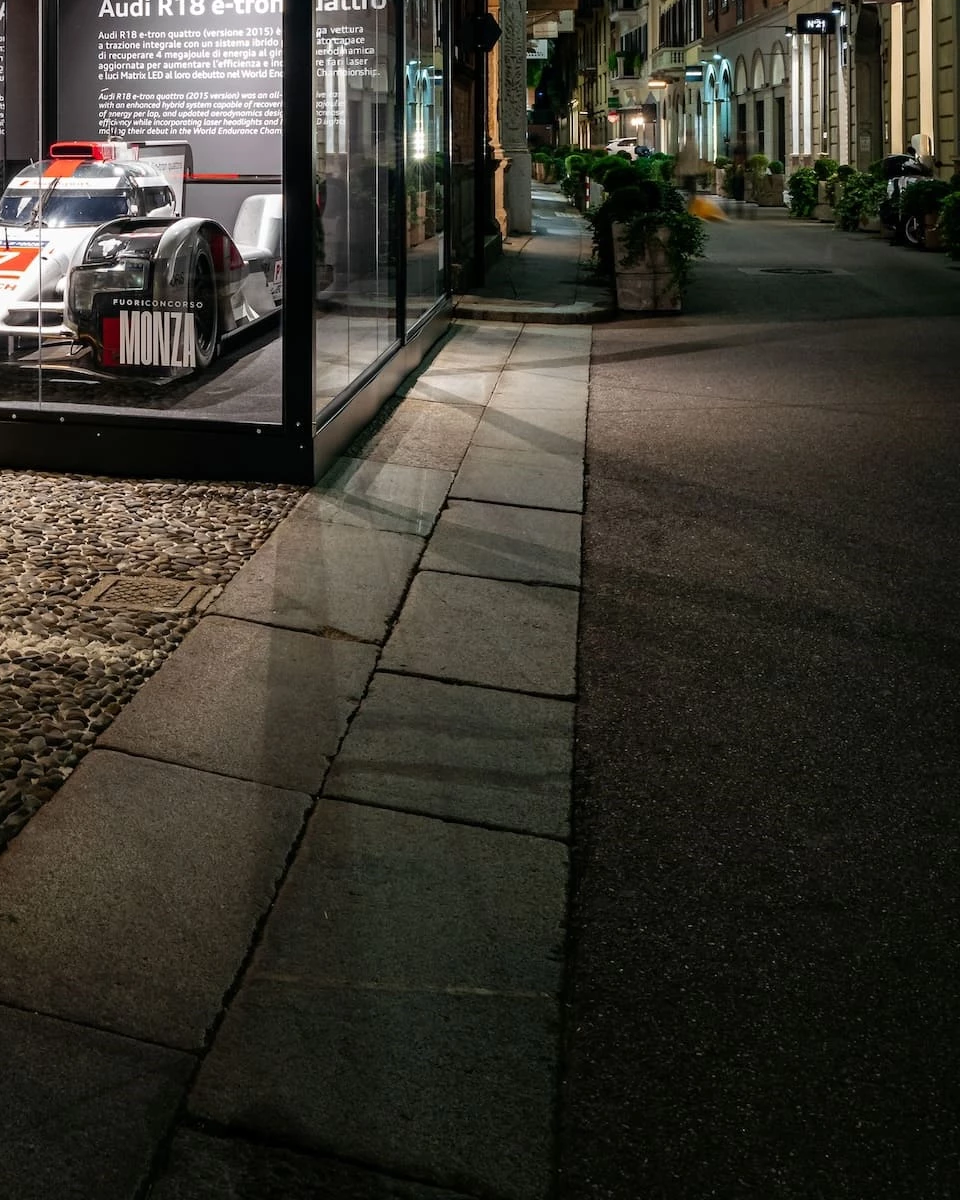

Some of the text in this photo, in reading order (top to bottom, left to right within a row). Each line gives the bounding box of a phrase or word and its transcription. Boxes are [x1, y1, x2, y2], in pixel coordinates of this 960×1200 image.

[98, 31, 118, 39] Audi
[120, 30, 137, 39] R18
[139, 31, 166, 39] e-tron
[167, 30, 201, 40] quattro
[203, 28, 244, 38] (versione
[245, 27, 273, 37] 2015)
[105, 41, 140, 49] trazione
[142, 40, 181, 51] integrale
[252, 38, 279, 46] ibrido
[98, 51, 106, 59] di
[109, 52, 154, 61] recuperare
[164, 49, 210, 60] megajoule
[212, 49, 221, 57] di
[223, 48, 256, 59] energia
[258, 48, 267, 56] al
[98, 61, 145, 71] aggiornata
[147, 62, 161, 71] per
[163, 61, 211, 69] aumentare
[105, 71, 118, 80] luci
[120, 71, 146, 80] Matrix
[148, 71, 163, 79] LED
[164, 71, 173, 79] al
[174, 71, 190, 79] loro
[192, 70, 225, 79] debutto
[227, 70, 240, 78] nel
[241, 69, 268, 78] World
[156, 93, 184, 102] quattro
[185, 92, 209, 100] (2015
[210, 91, 240, 100] version)
[98, 101, 114, 109] with
[161, 101, 185, 110] hybrid
[186, 102, 212, 110] system
[213, 101, 243, 109] capable
[243, 100, 253, 109] of
[98, 110, 107, 118] of
[133, 111, 146, 119] per
[147, 110, 160, 118] lap,
[178, 110, 210, 118] updated
[210, 110, 263, 118] aerodynamics
[153, 119, 202, 127] incorporating
[203, 118, 222, 126] laser
[223, 118, 262, 127] headlights
[112, 298, 204, 309] FUORICONCORSO
[120, 310, 196, 368] MONZA
